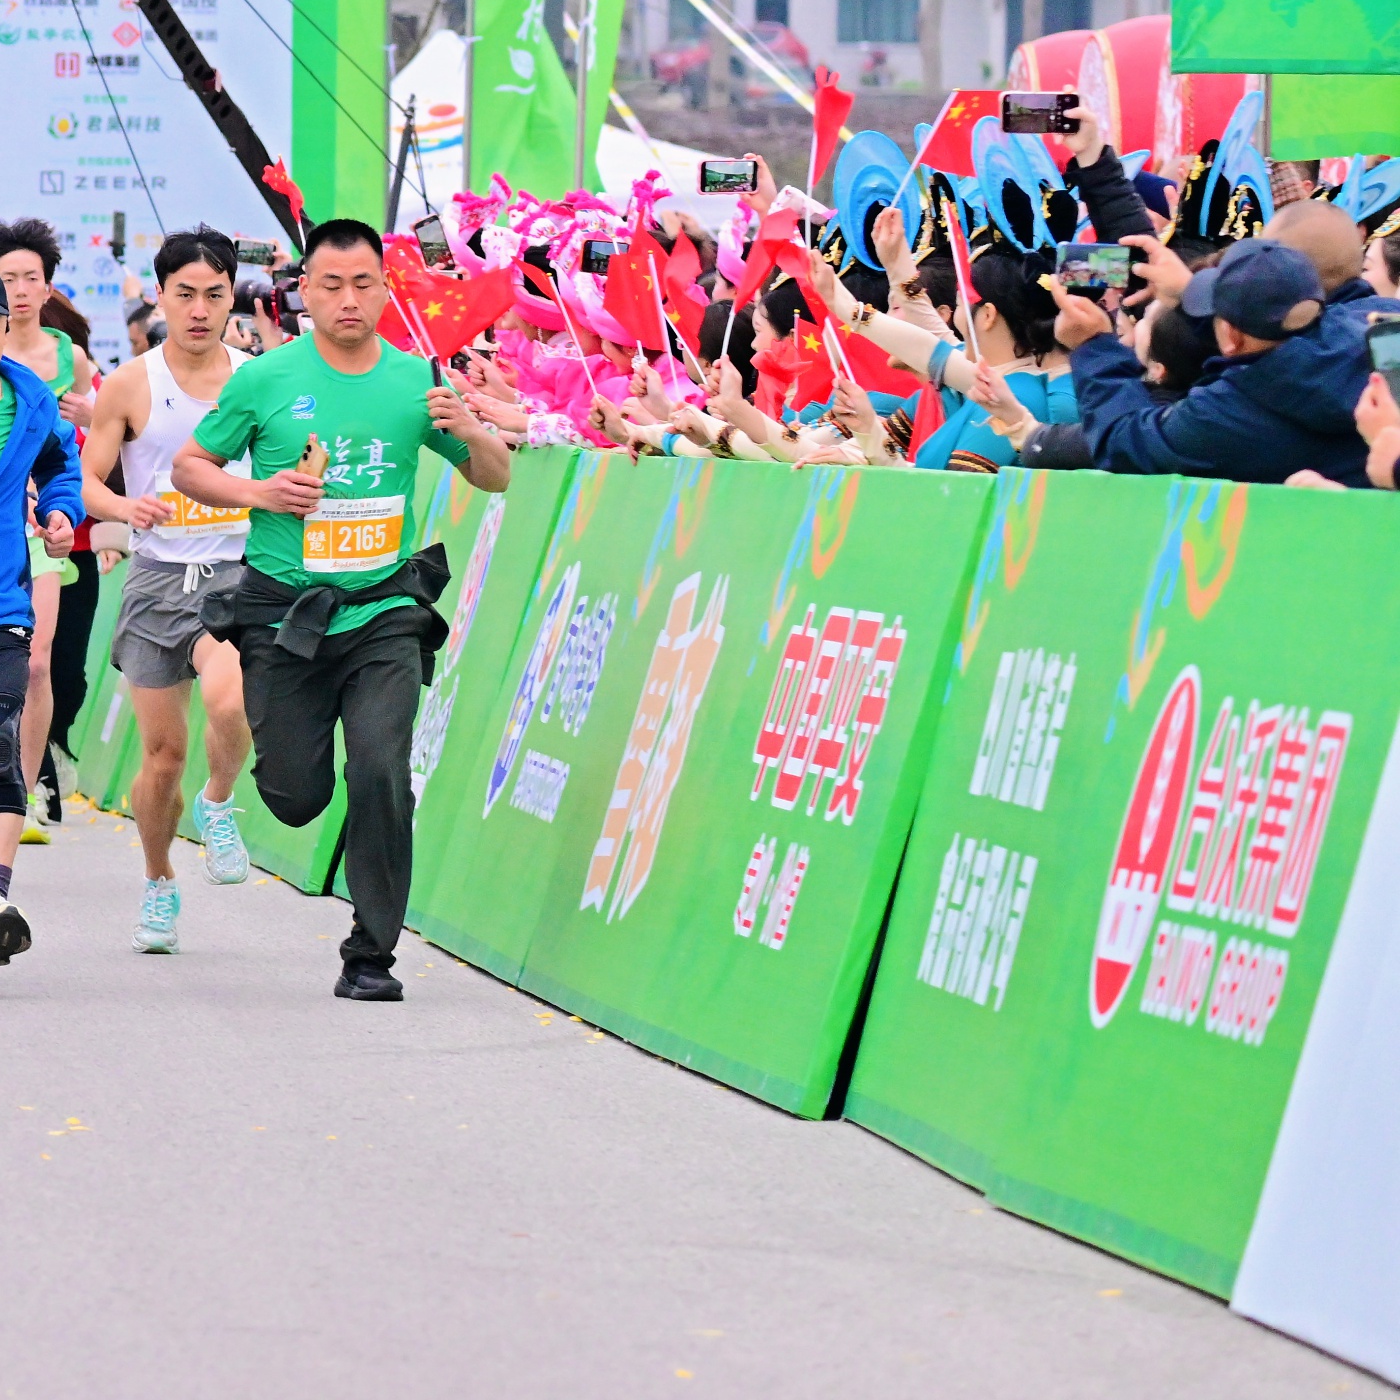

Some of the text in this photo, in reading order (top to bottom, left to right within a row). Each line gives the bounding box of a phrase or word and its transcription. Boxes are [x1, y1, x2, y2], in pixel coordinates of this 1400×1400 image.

[74, 175, 168, 190] ZEEKR
[337, 523, 387, 553] 2165
[750, 603, 907, 826] 中国平安
[1166, 695, 1354, 940] 台沃集团
[1140, 918, 1290, 1048] TAIWO GROUP
